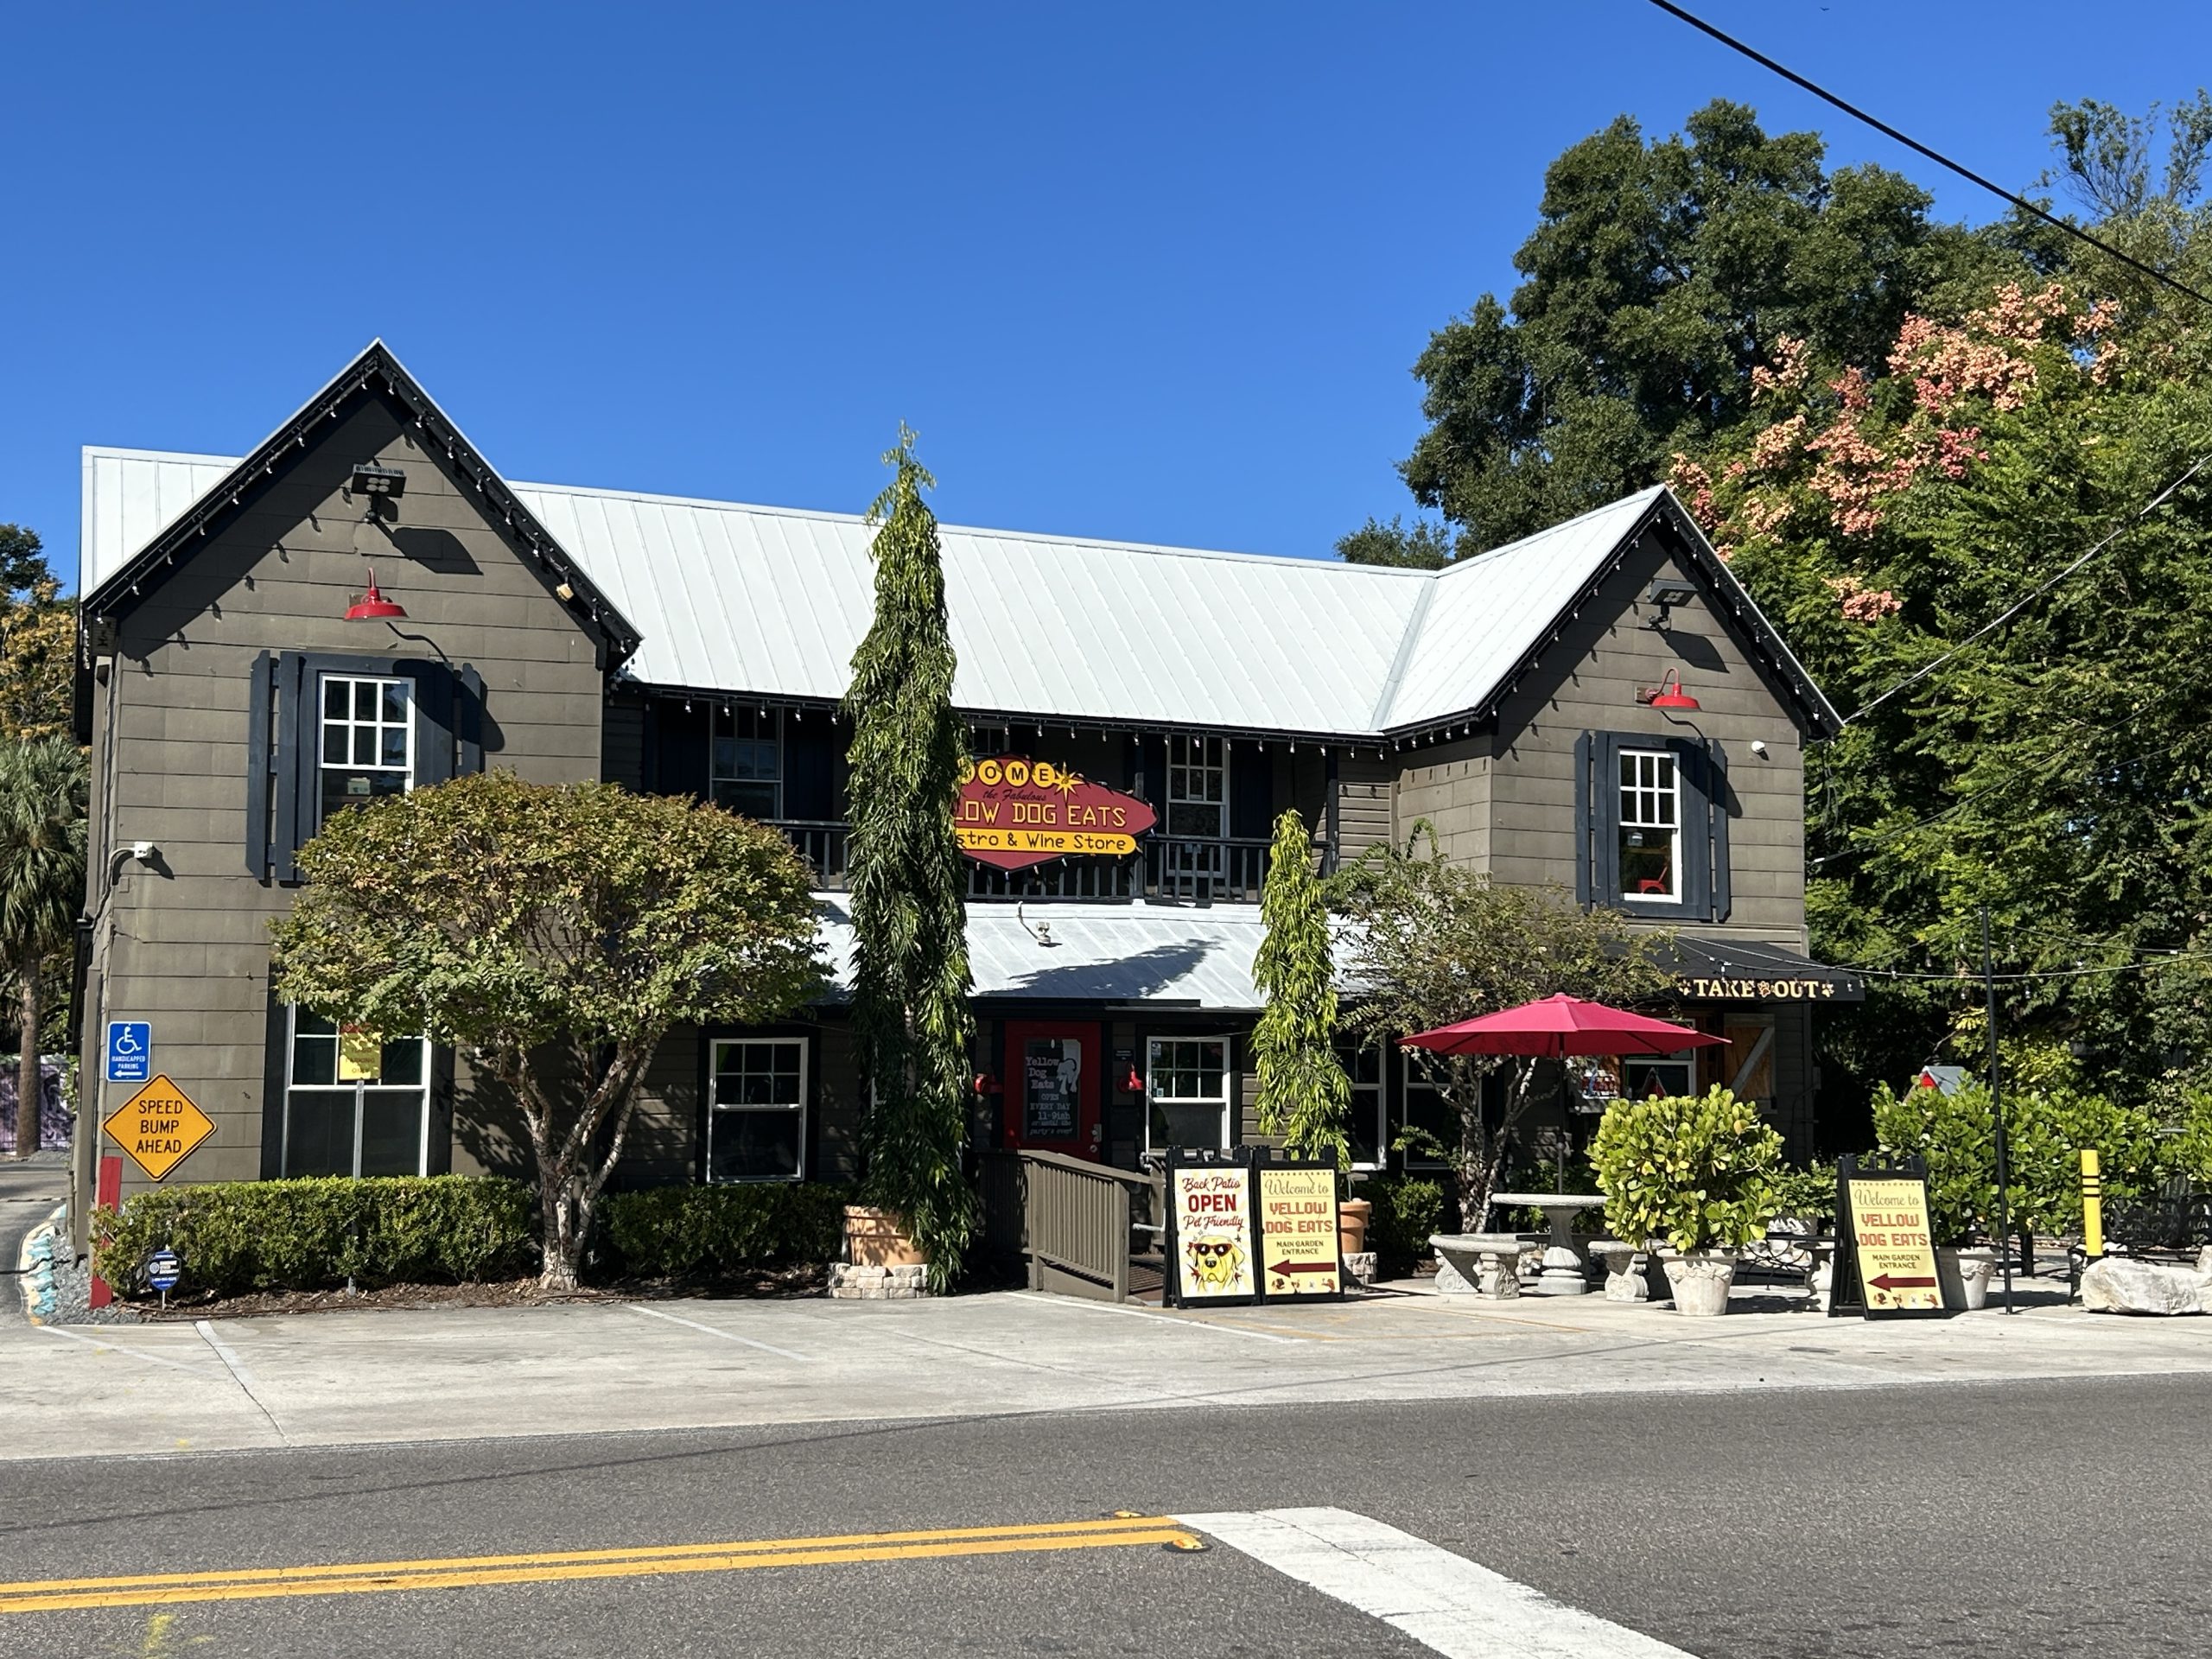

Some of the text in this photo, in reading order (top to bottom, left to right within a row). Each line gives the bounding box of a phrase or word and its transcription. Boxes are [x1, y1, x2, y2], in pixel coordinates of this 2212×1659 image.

[982, 788, 1048, 802] the Fabulous
[1012, 802, 1058, 824] DOG
[1067, 804, 1127, 828] EATS
[1007, 831, 1018, 847] &
[1073, 834, 1127, 850] Store
[1693, 979, 1819, 999] TAKE OUT
[1025, 1056, 1060, 1066] Yellow
[1028, 1067, 1047, 1079] Dog
[1031, 1079, 1055, 1090] Eats
[138, 1099, 183, 1115] SPEED
[140, 1119, 180, 1135] BUMP
[136, 1139, 182, 1154] AHEAD
[1182, 1176, 1241, 1193] Back Patio
[1264, 1179, 1329, 1196] Welcome to
[1188, 1193, 1237, 1213] OPEN
[1853, 1189, 1919, 1206] Welcome to
[1269, 1201, 1327, 1216] YELLOW
[1183, 1215, 1245, 1232] Pet Friendly
[1265, 1220, 1333, 1234] DOG EATS
[1860, 1213, 1920, 1227] YELLOW
[1859, 1233, 1928, 1247] DOG EATS
